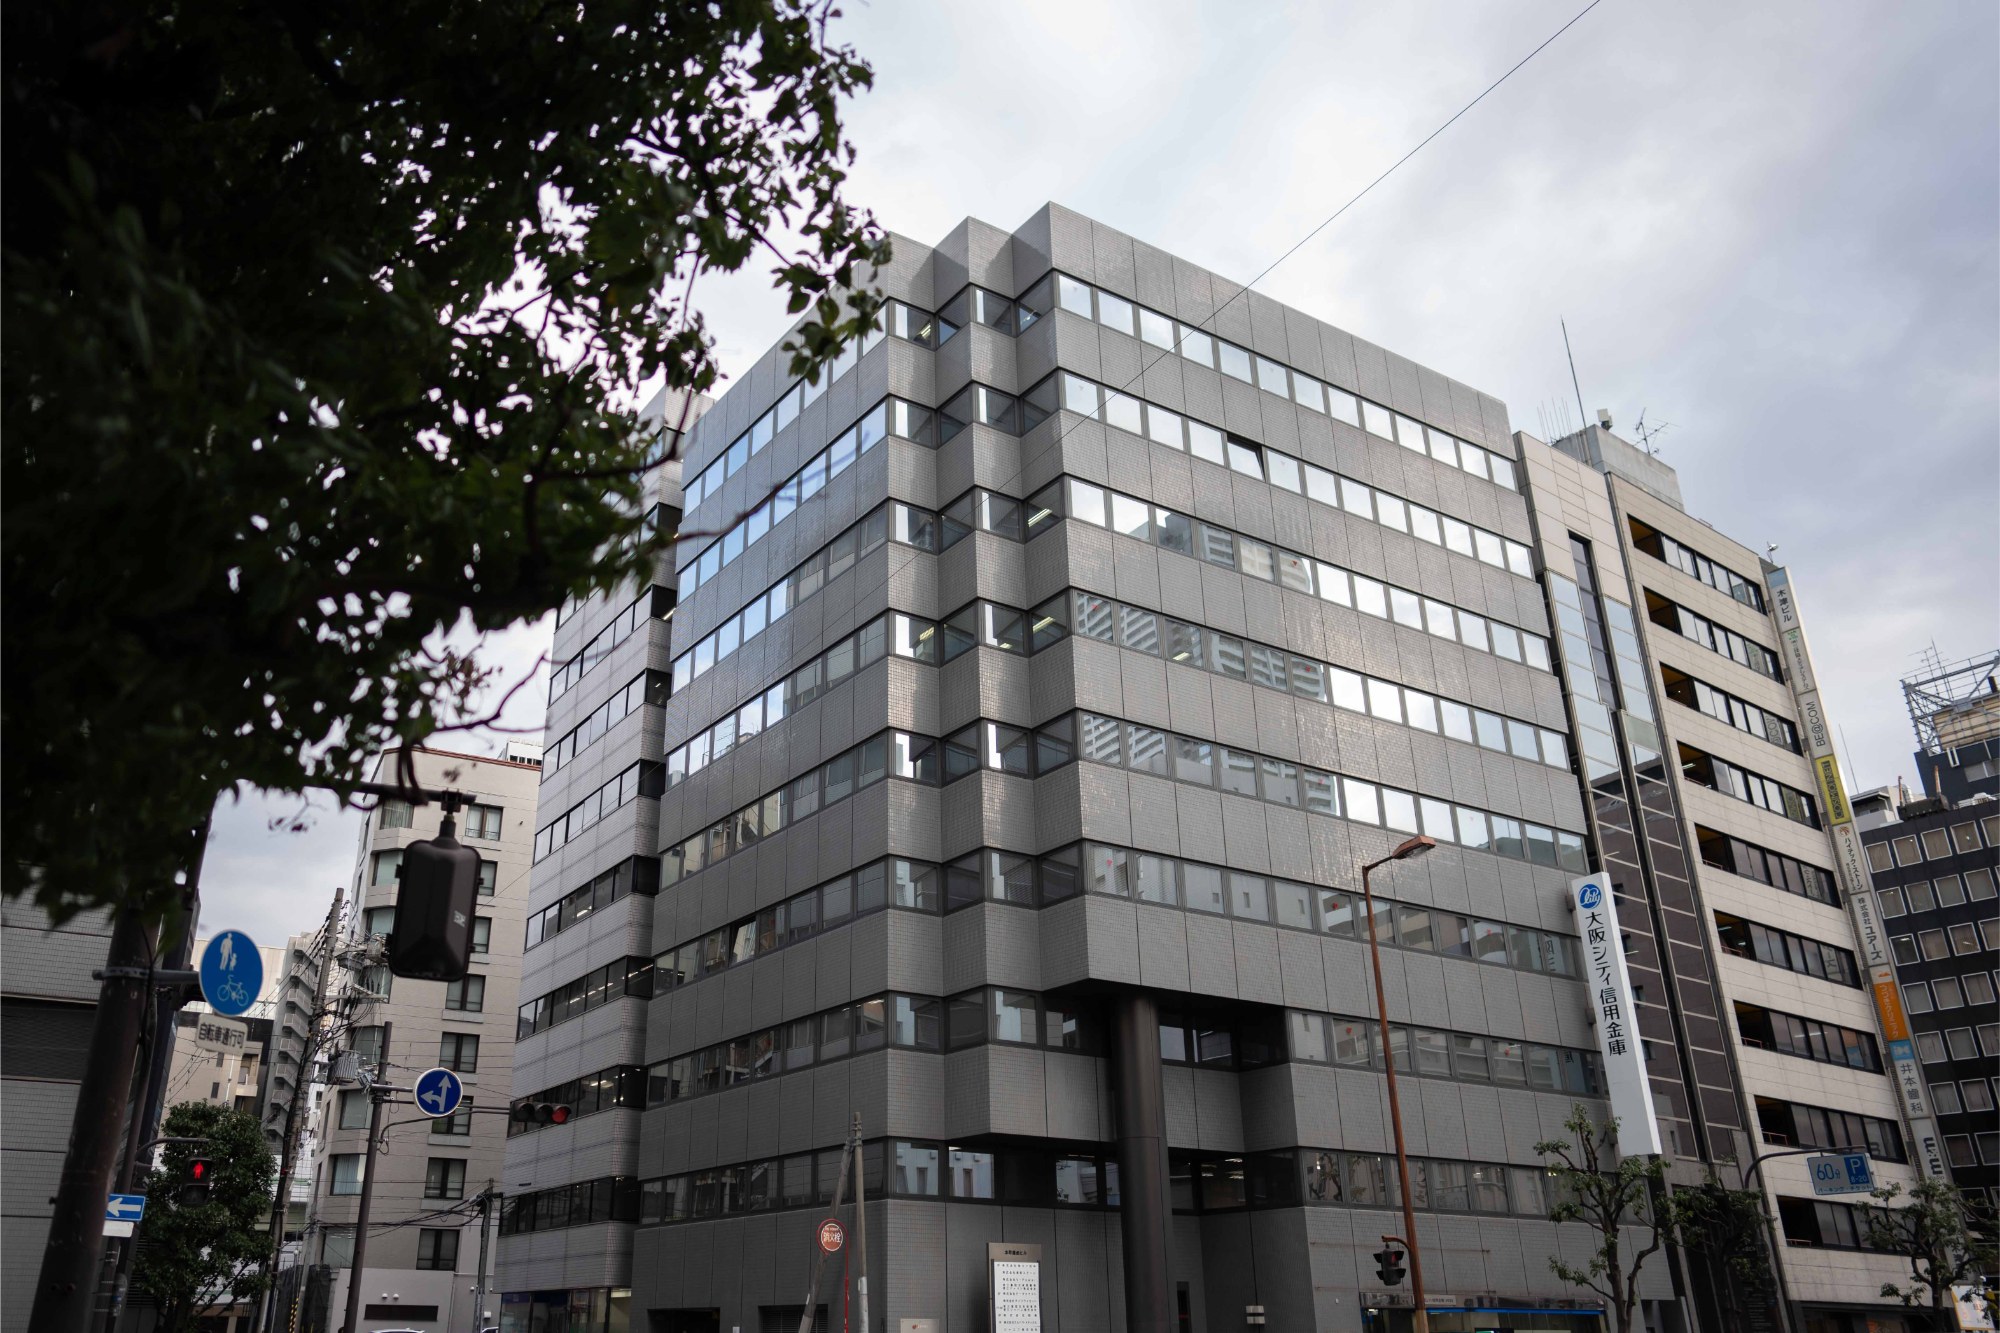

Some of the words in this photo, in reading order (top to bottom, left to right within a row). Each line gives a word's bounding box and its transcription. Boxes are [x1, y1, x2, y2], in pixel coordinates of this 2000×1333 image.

[1805, 700, 1826, 748] BE@COM
[1585, 911, 1628, 1057] 大阪シティ信用金庫
[198, 1023, 246, 1049] 自転車通行可
[1900, 1063, 1924, 1114] 井本歯科
[1850, 1158, 1861, 1174] P
